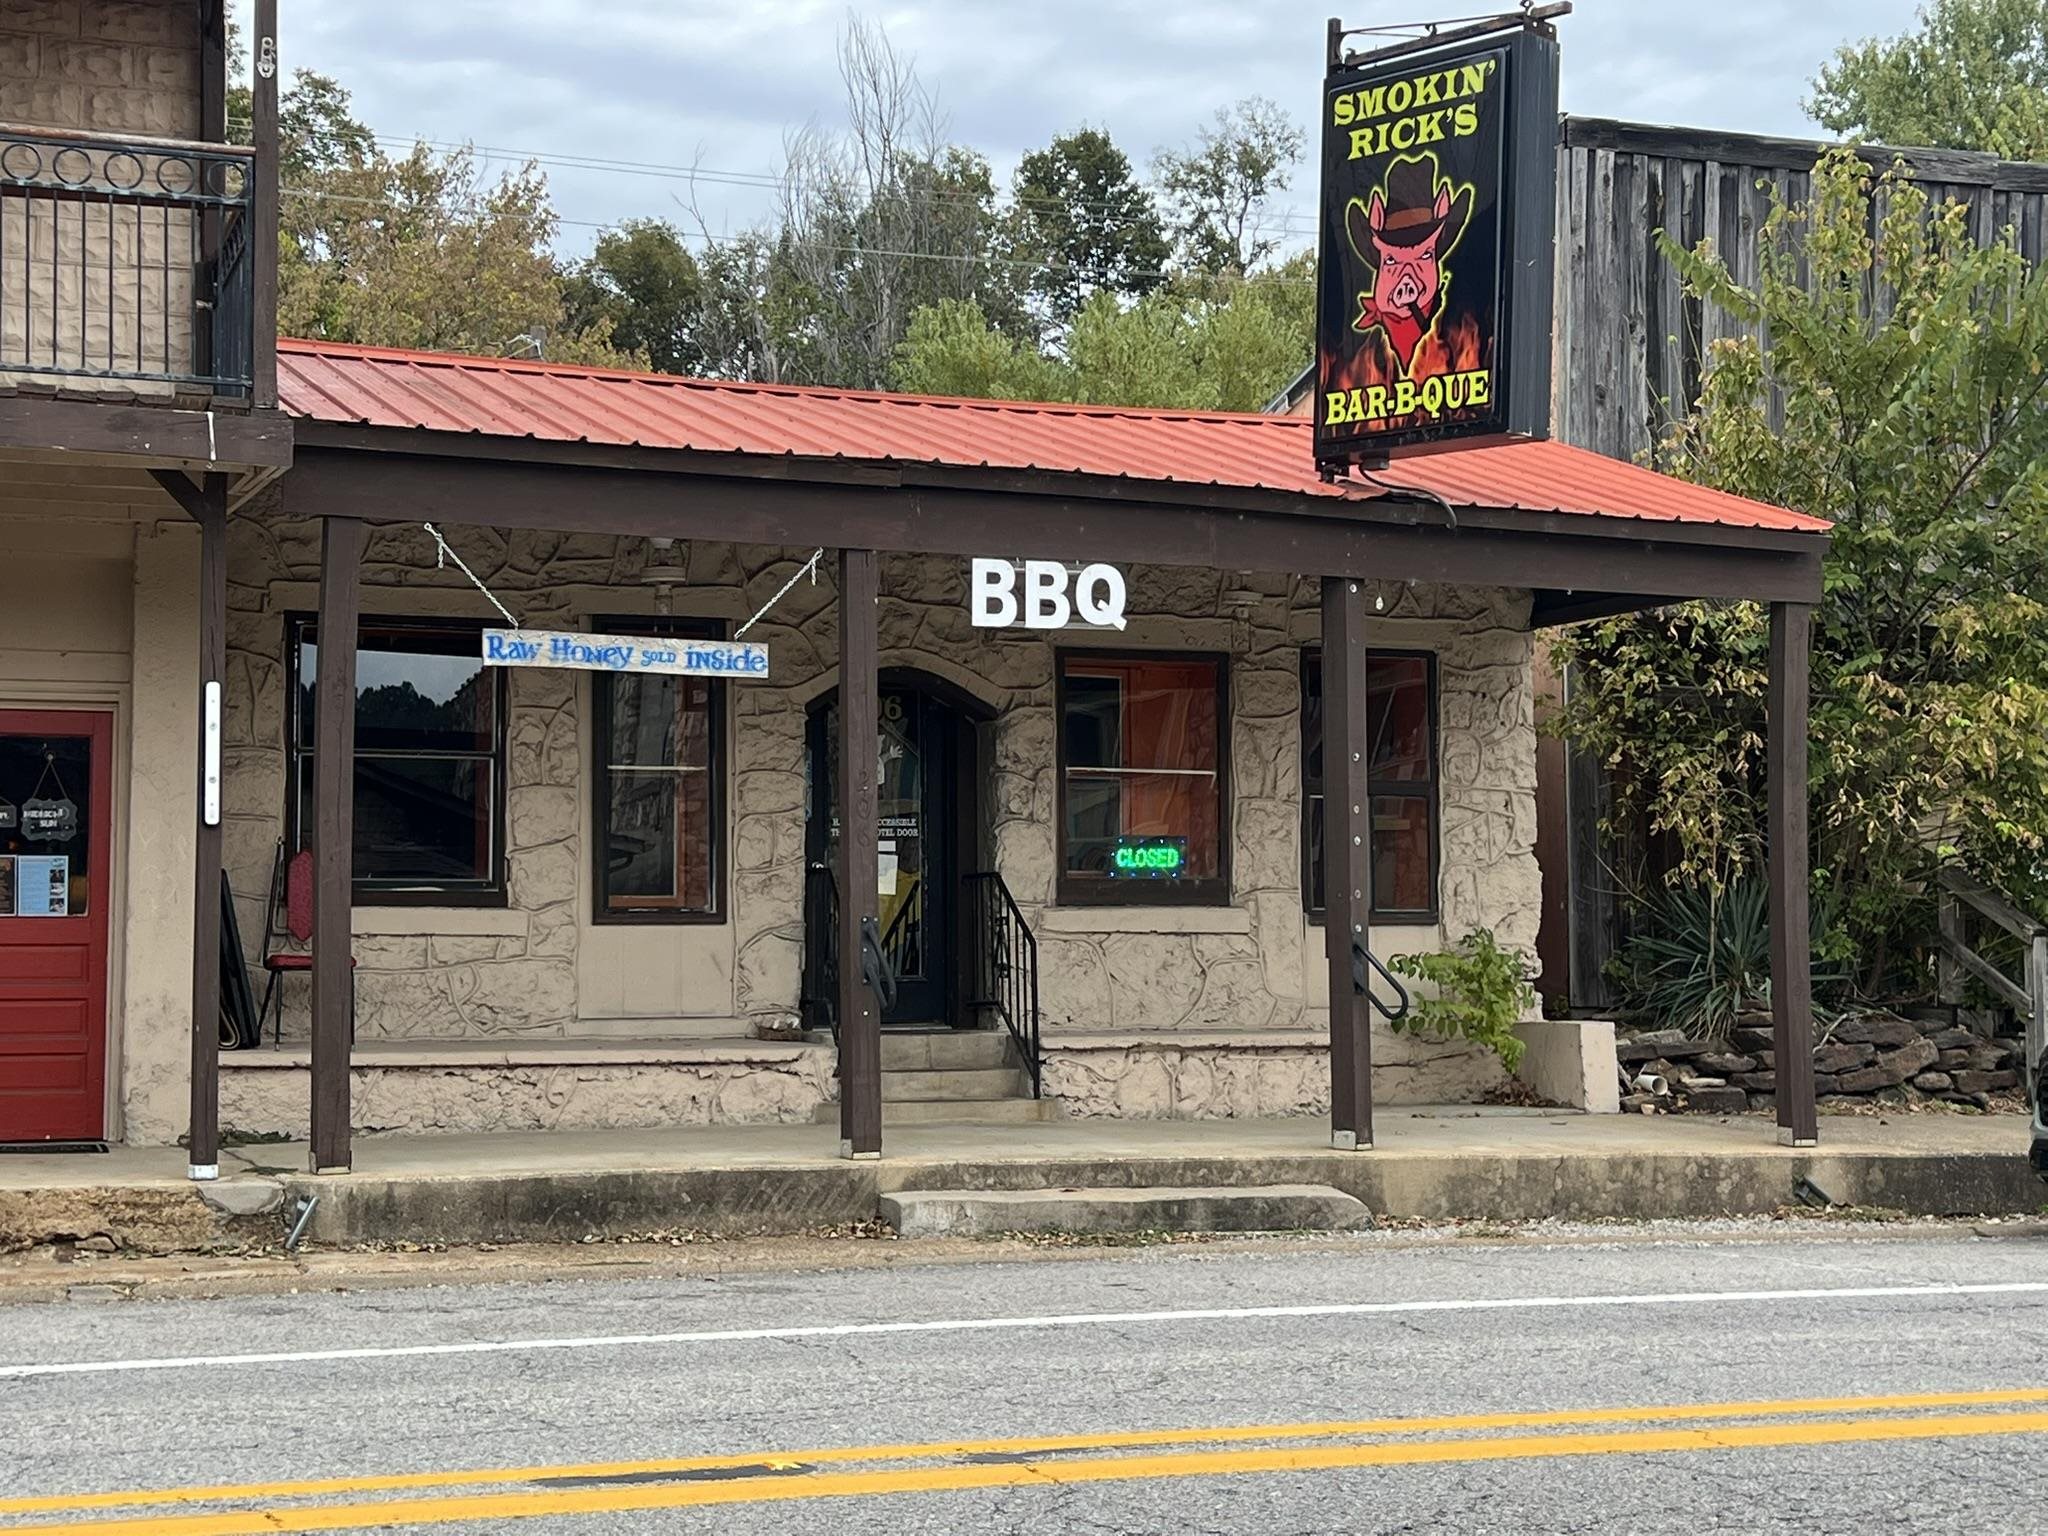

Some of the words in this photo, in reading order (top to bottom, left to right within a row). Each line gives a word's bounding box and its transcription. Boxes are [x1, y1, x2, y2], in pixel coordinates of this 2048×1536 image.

[1334, 59, 1496, 126] SMOKIN'
[1347, 102, 1478, 160] RICK'S
[1325, 370, 1489, 426] BAR-B-QUE
[971, 558, 1127, 631] BBQ
[877, 695, 902, 720] 6
[877, 818, 917, 827] CCESSIBLE
[896, 828, 919, 837] DOOR
[1116, 847, 1179, 868] CLOSED
